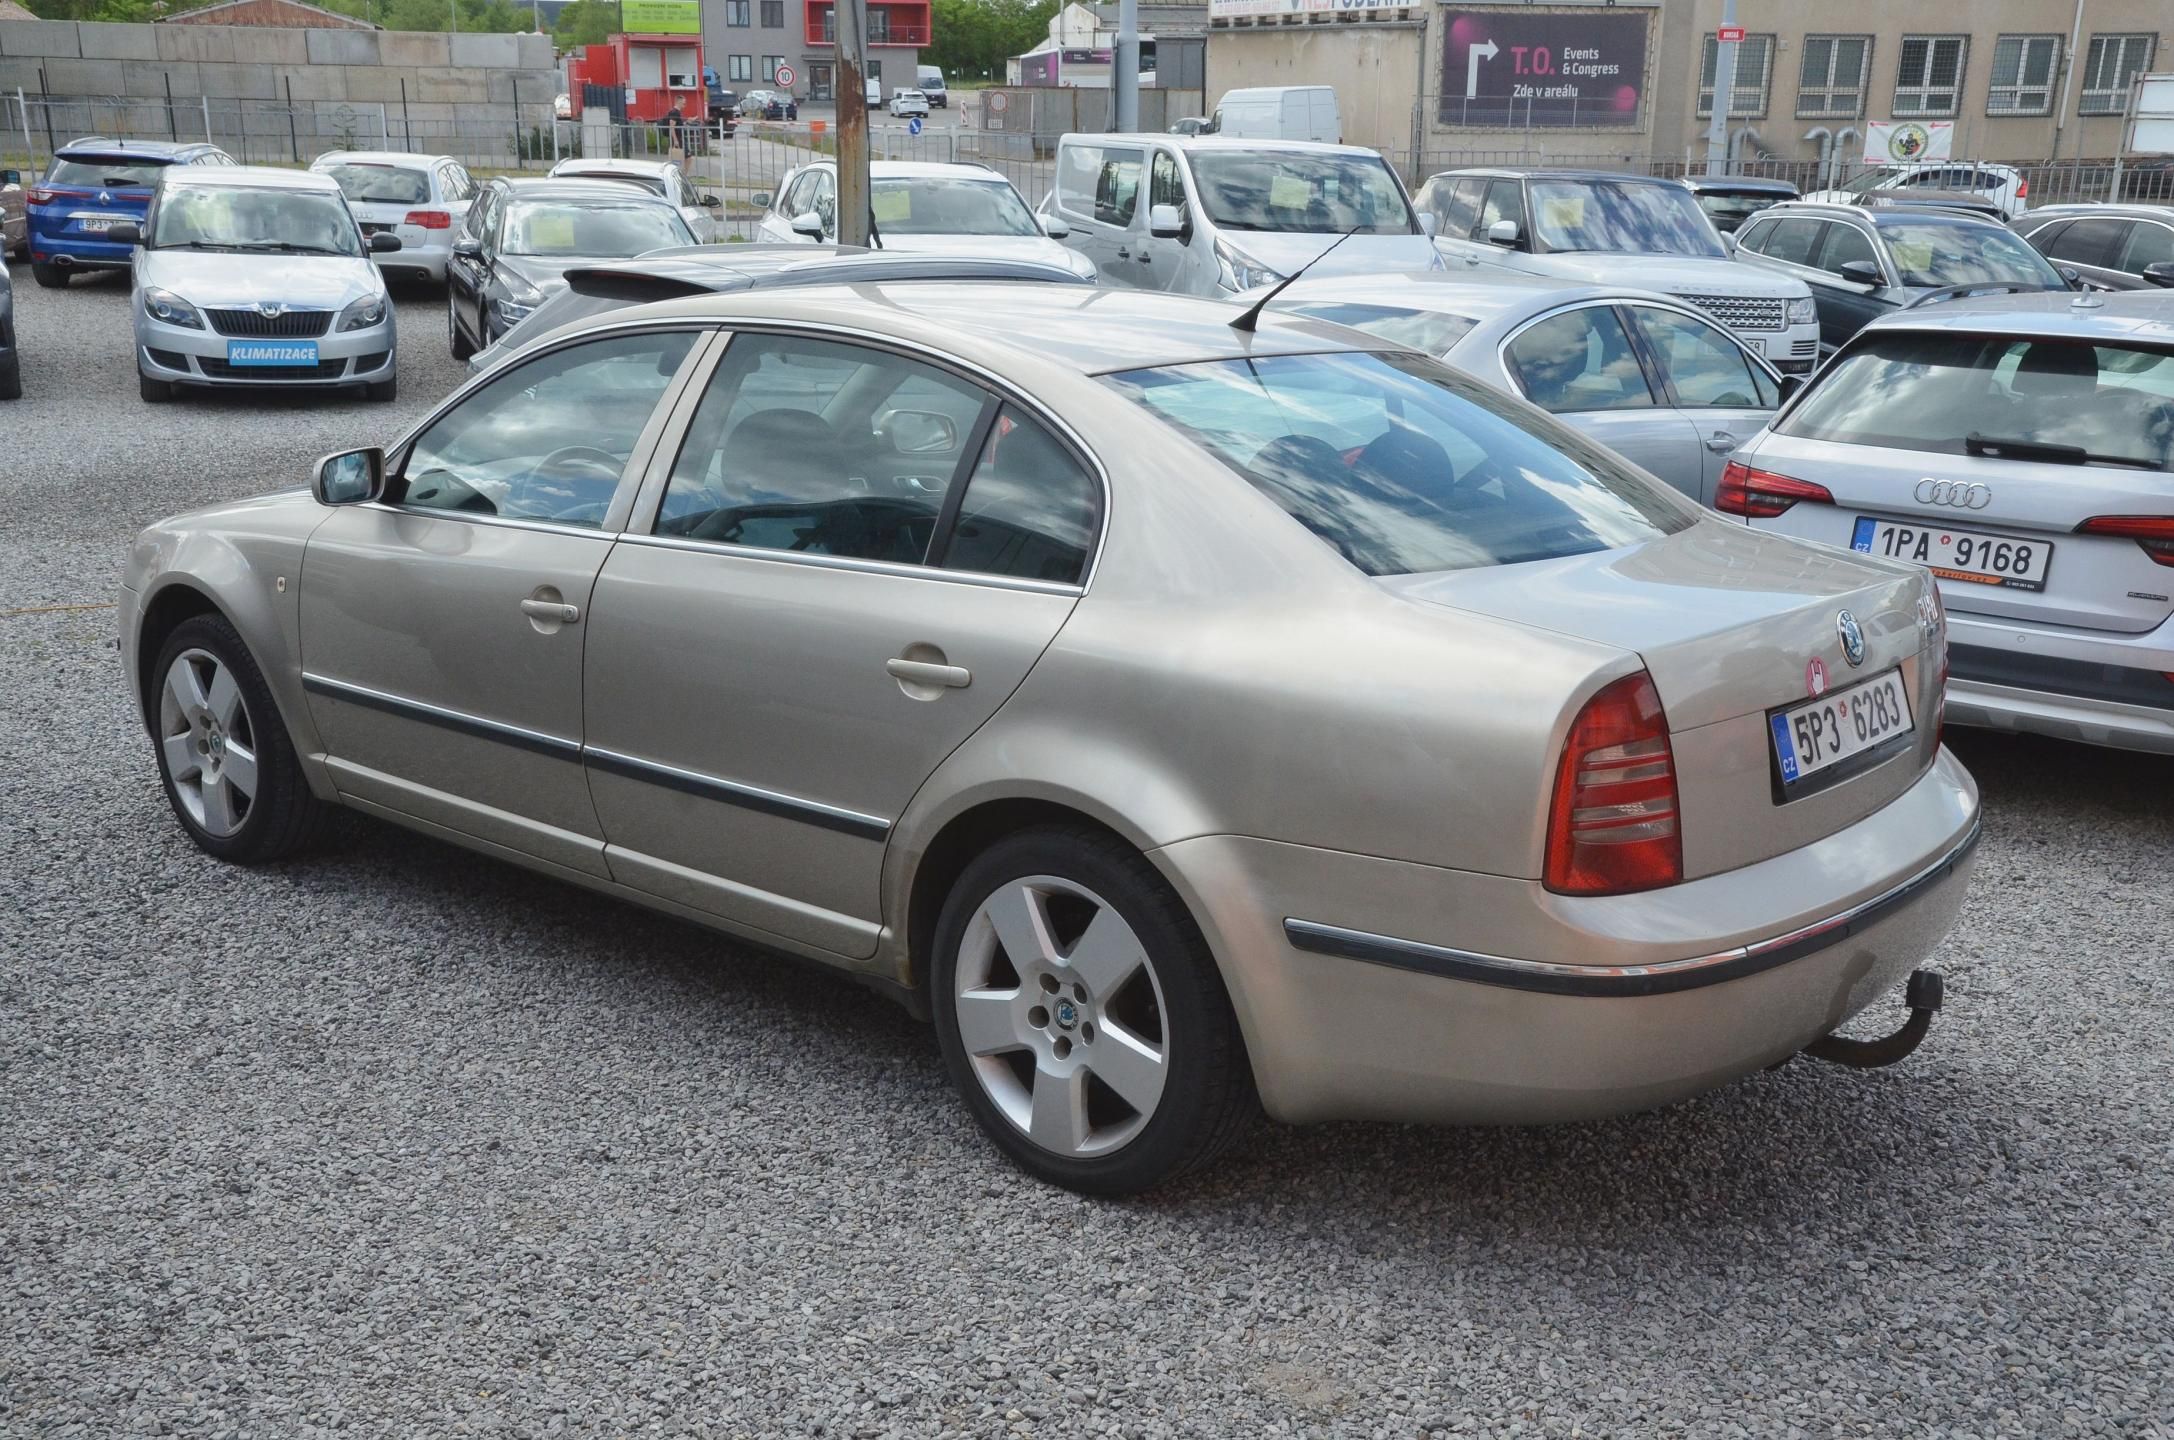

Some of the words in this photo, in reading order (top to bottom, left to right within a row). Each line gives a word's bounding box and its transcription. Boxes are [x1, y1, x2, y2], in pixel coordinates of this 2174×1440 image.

[1564, 48, 1600, 60] Events
[1511, 47, 1556, 75] T.O.
[781, 72, 790, 81] 10
[1562, 63, 1571, 75] &
[1572, 63, 1619, 77] Congress
[1513, 84, 1534, 97] Zde
[1536, 87, 1543, 97] v
[1544, 84, 1578, 97] areálu
[85, 220, 104, 230] 9P3
[231, 347, 317, 360] KLIMATIZACE
[1855, 542, 1869, 552] CZ
[1881, 527, 1930, 562] 1PA
[1954, 538, 2033, 575] 9168
[1793, 706, 1841, 765] 5P3
[1851, 681, 1901, 742] 6283
[1783, 756, 1796, 774] CZ
